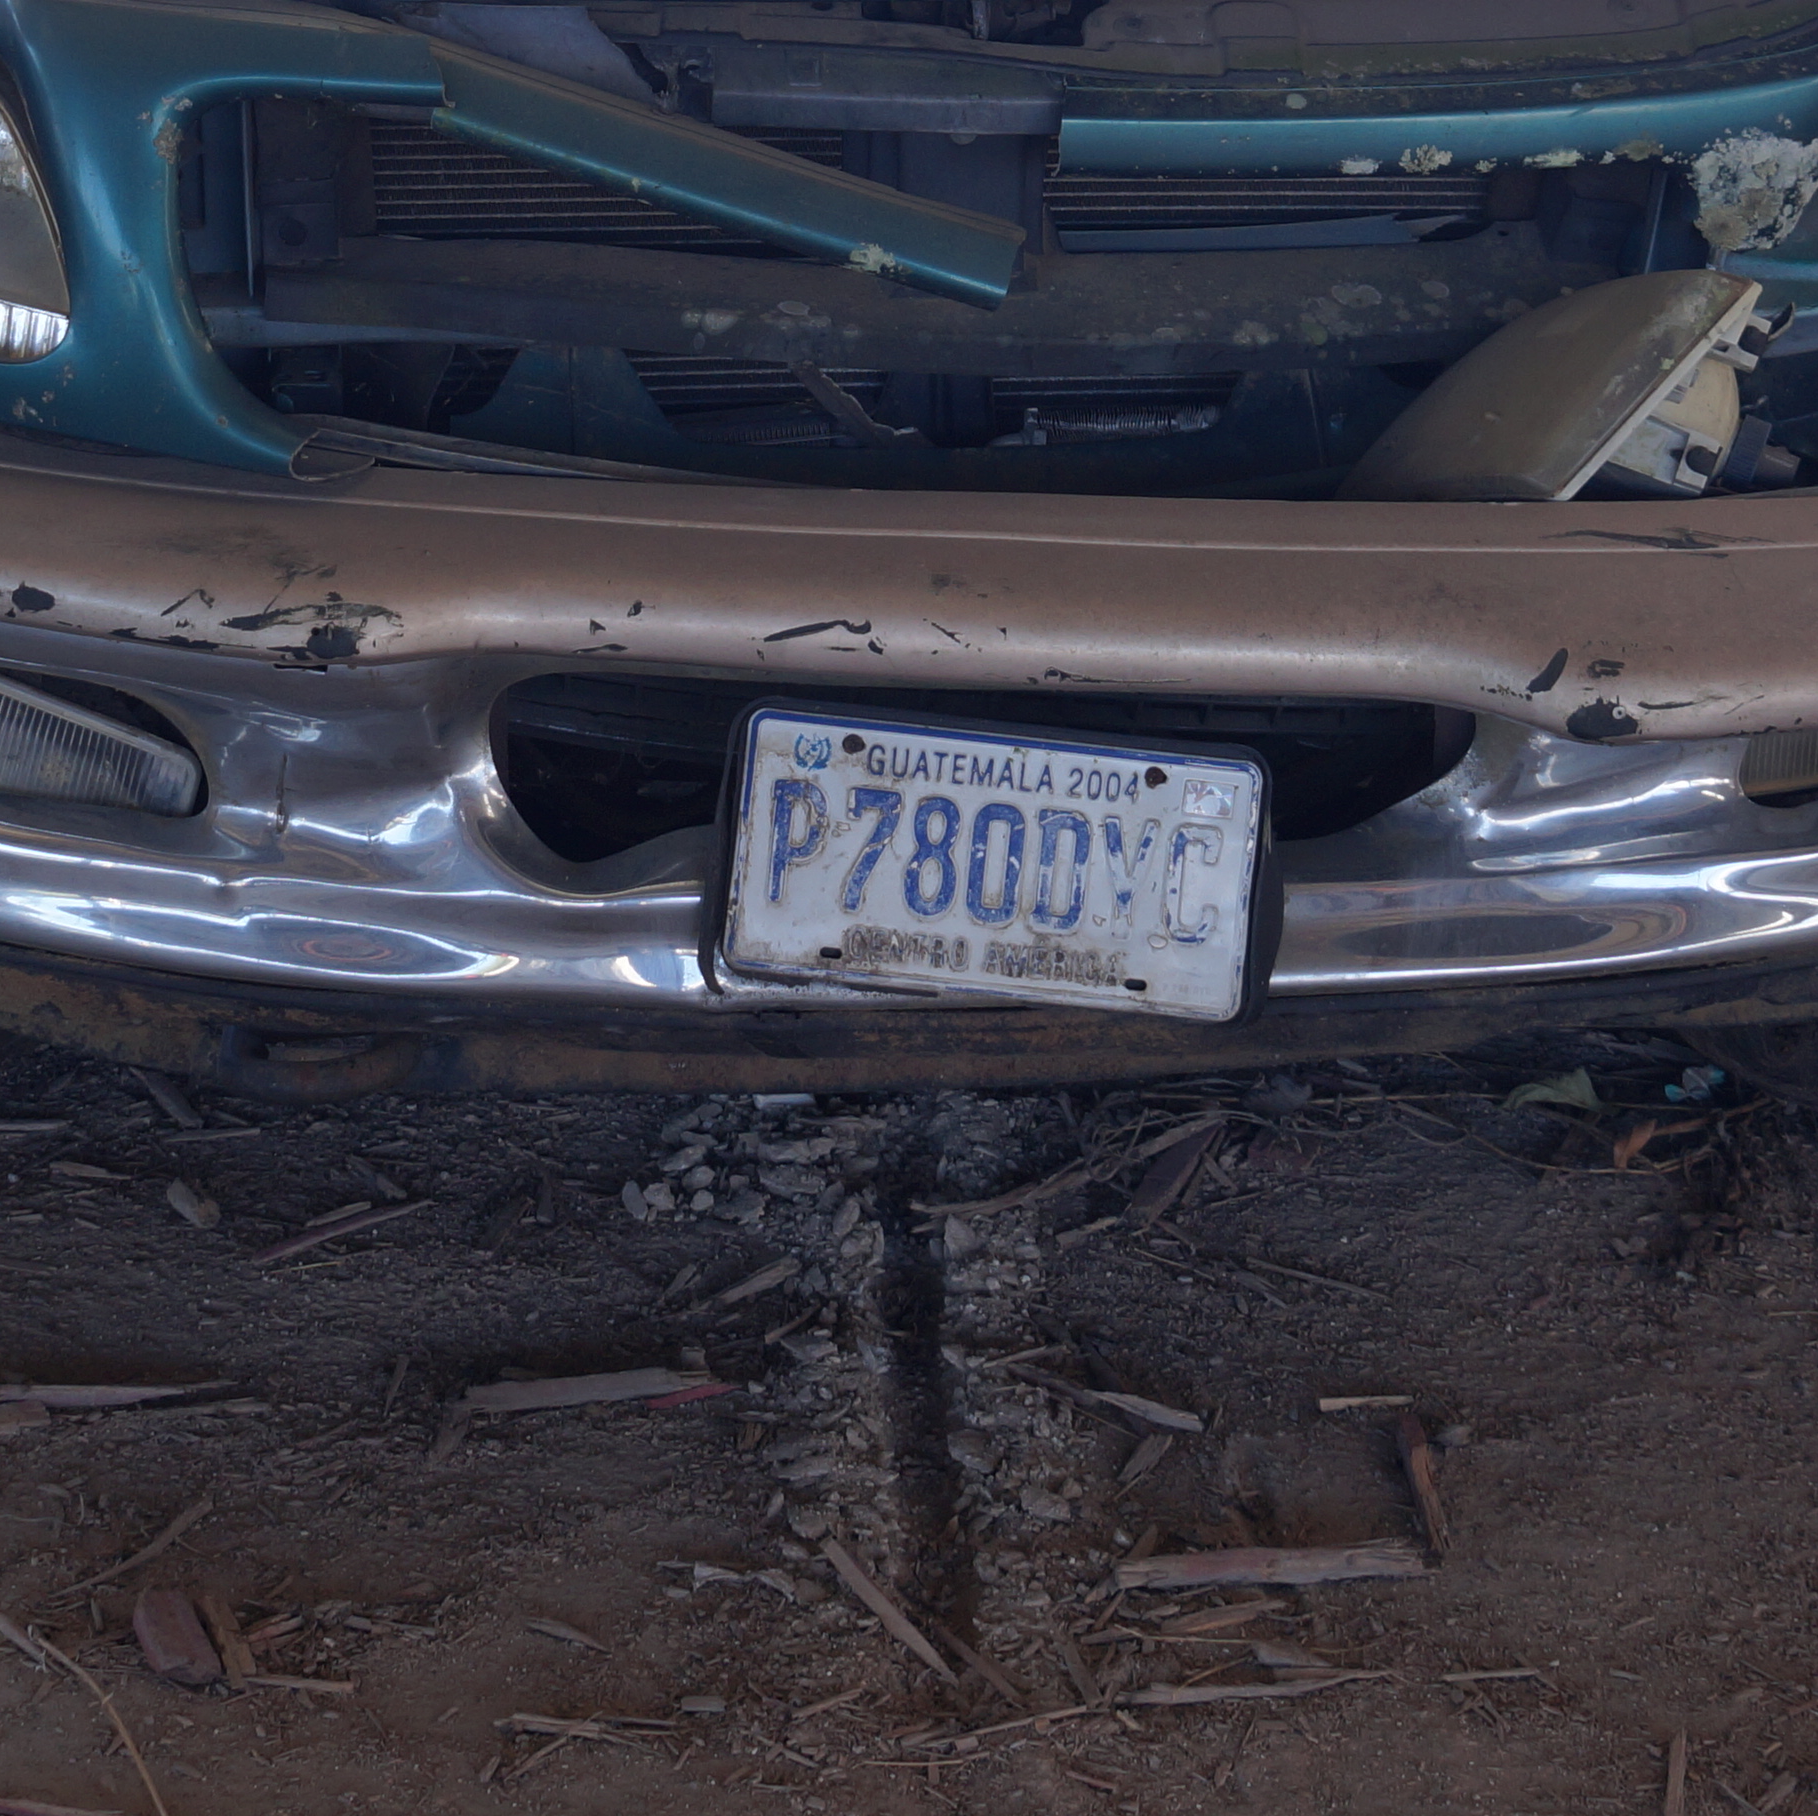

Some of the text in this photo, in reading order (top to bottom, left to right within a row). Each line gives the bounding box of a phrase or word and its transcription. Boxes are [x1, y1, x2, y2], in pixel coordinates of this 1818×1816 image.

[866, 743, 1140, 803] GUATEMALA 2004
[844, 924, 969, 973] CENTRO
